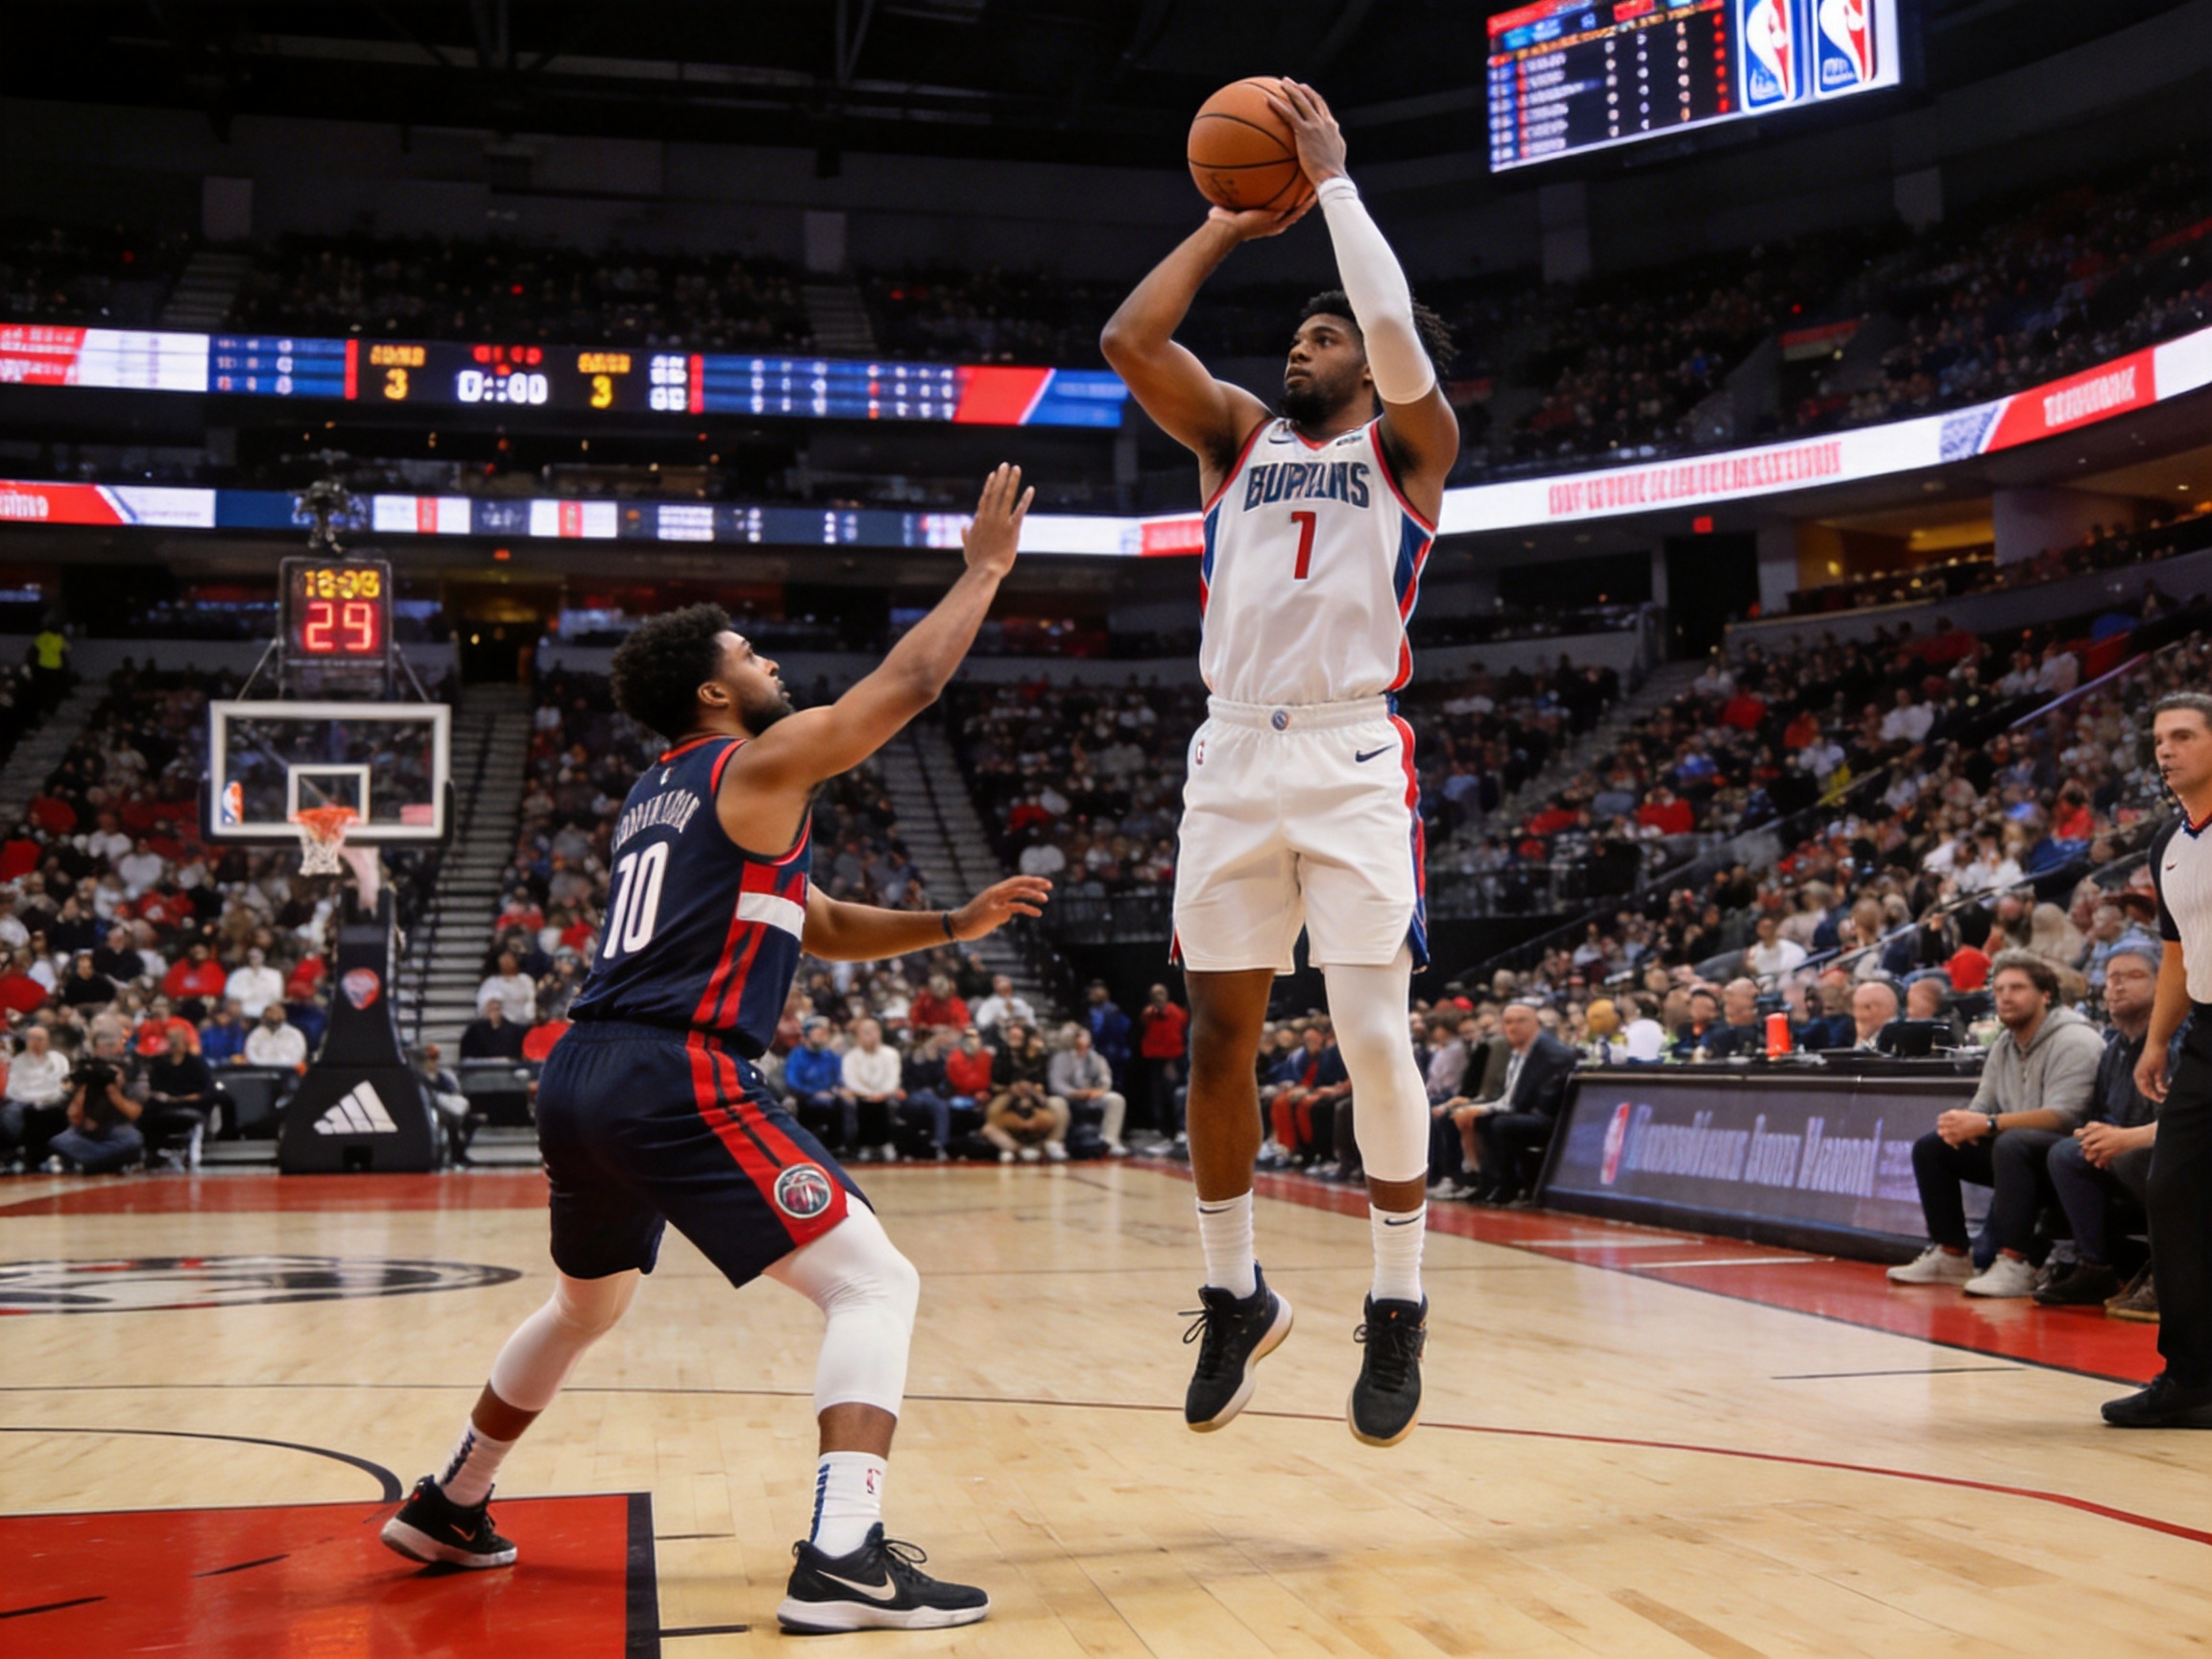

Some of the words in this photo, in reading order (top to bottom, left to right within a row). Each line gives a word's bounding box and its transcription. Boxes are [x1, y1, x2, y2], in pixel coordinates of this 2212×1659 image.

[384, 368, 408, 400] 3
[591, 375, 612, 408] 3
[306, 602, 373, 651] 29
